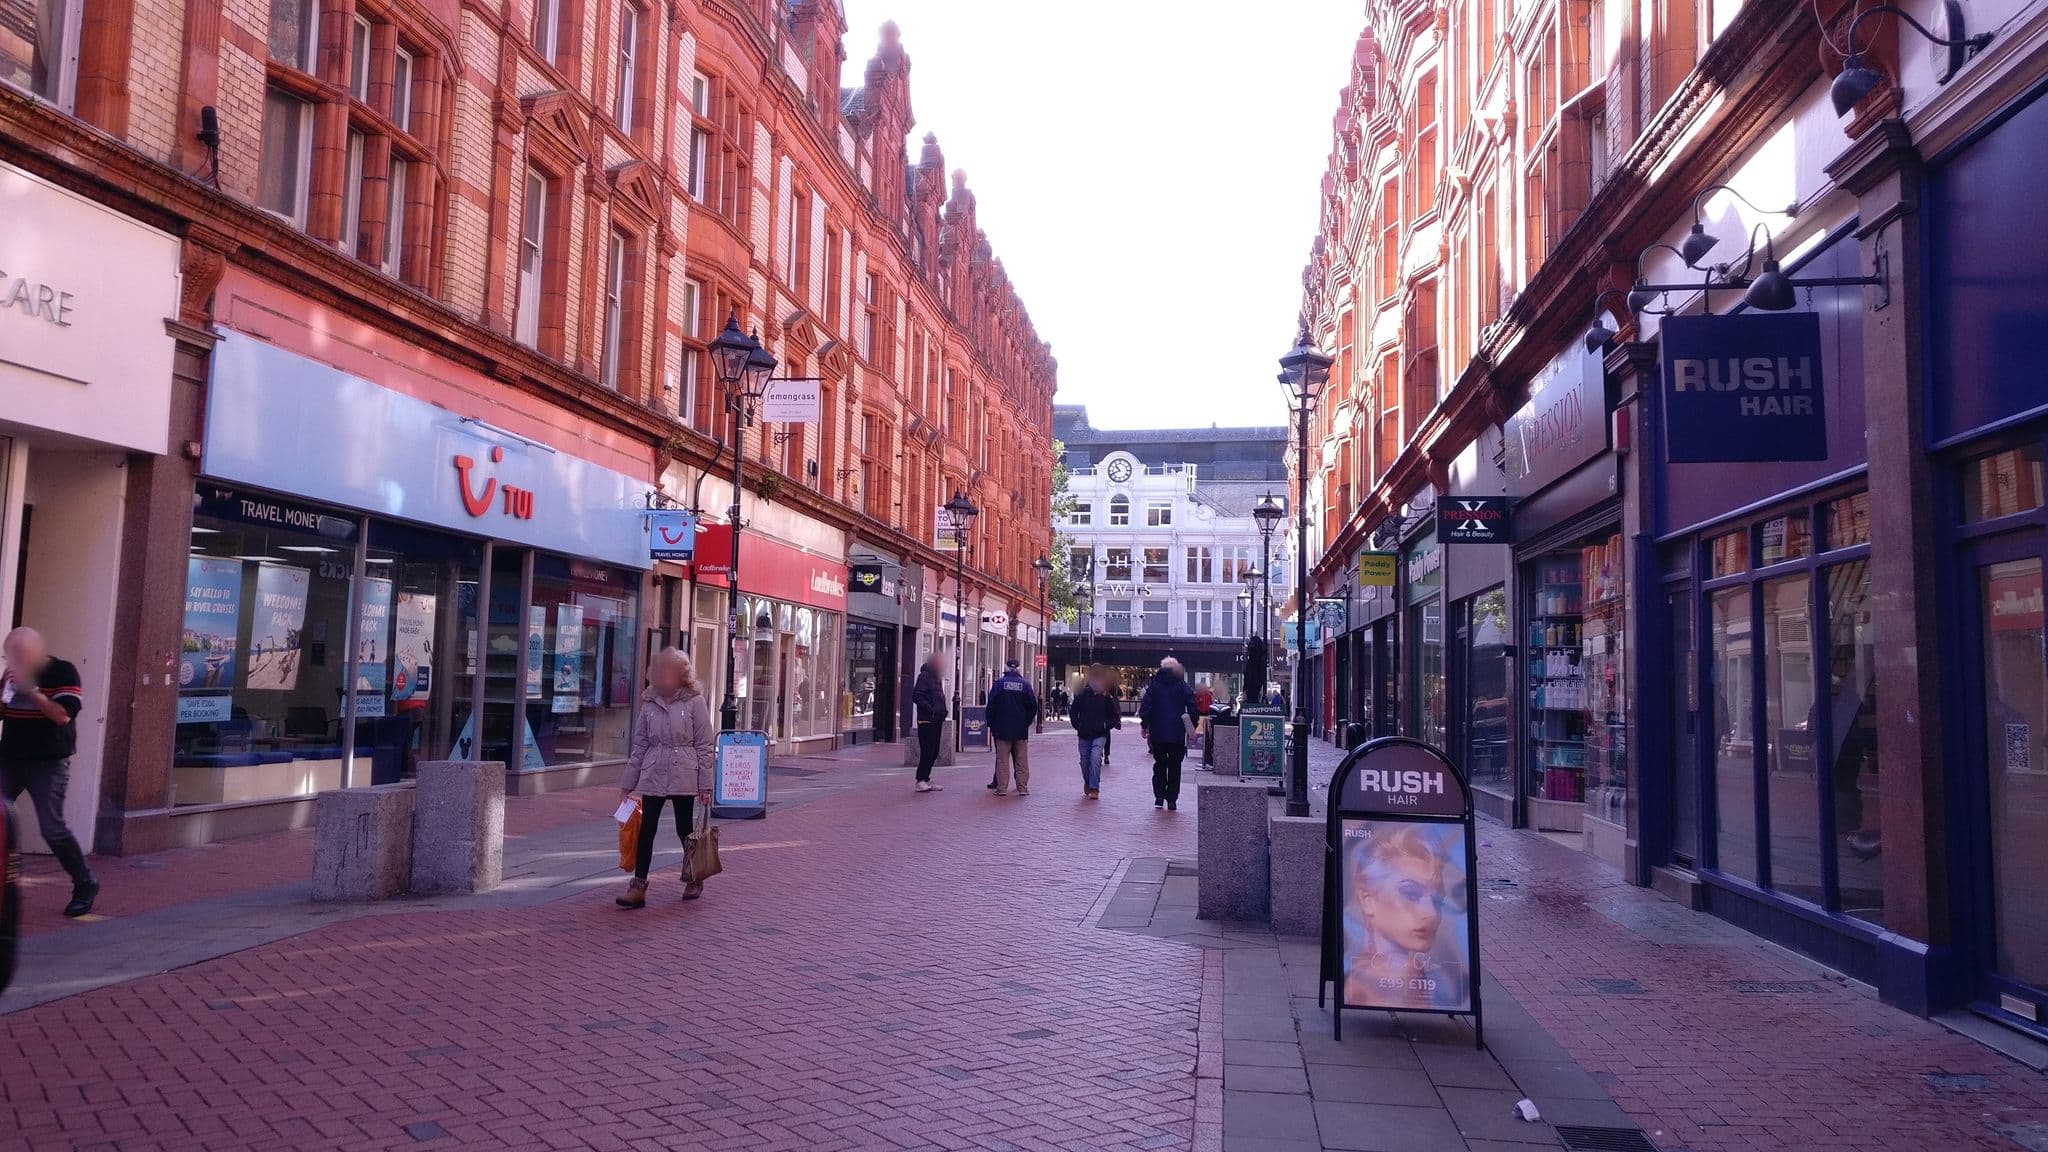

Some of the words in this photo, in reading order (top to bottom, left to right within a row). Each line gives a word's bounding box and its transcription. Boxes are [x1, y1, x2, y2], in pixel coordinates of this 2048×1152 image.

[1673, 356, 1812, 392] RUSH
[1740, 395, 1813, 417] HAIR
[502, 484, 533, 519] TUI
[240, 500, 282, 523] TRAVEL
[285, 508, 322, 529] MONEY
[699, 564, 731, 572] Ladbroke
[1364, 561, 1390, 569] Paddy
[810, 568, 845, 597] Ladbrokes
[190, 586, 201, 598] SAY
[202, 587, 222, 599] HELLO
[222, 589, 230, 599] TO
[1095, 584, 1152, 597] EWIS
[264, 593, 302, 609] WELCOME
[193, 602, 211, 613] RIVER
[212, 603, 235, 614] CRUISES
[272, 612, 293, 626] BACK
[361, 619, 378, 632] BACK
[181, 710, 192, 718] PER
[193, 710, 219, 718] BOOKING
[1250, 721, 1263, 740] 2
[1360, 769, 1444, 794] RUSH
[1387, 794, 1418, 806] HAIR
[1344, 829, 1372, 839] RUSH
[1379, 977, 1404, 988] £99
[1408, 978, 1437, 990] £119
